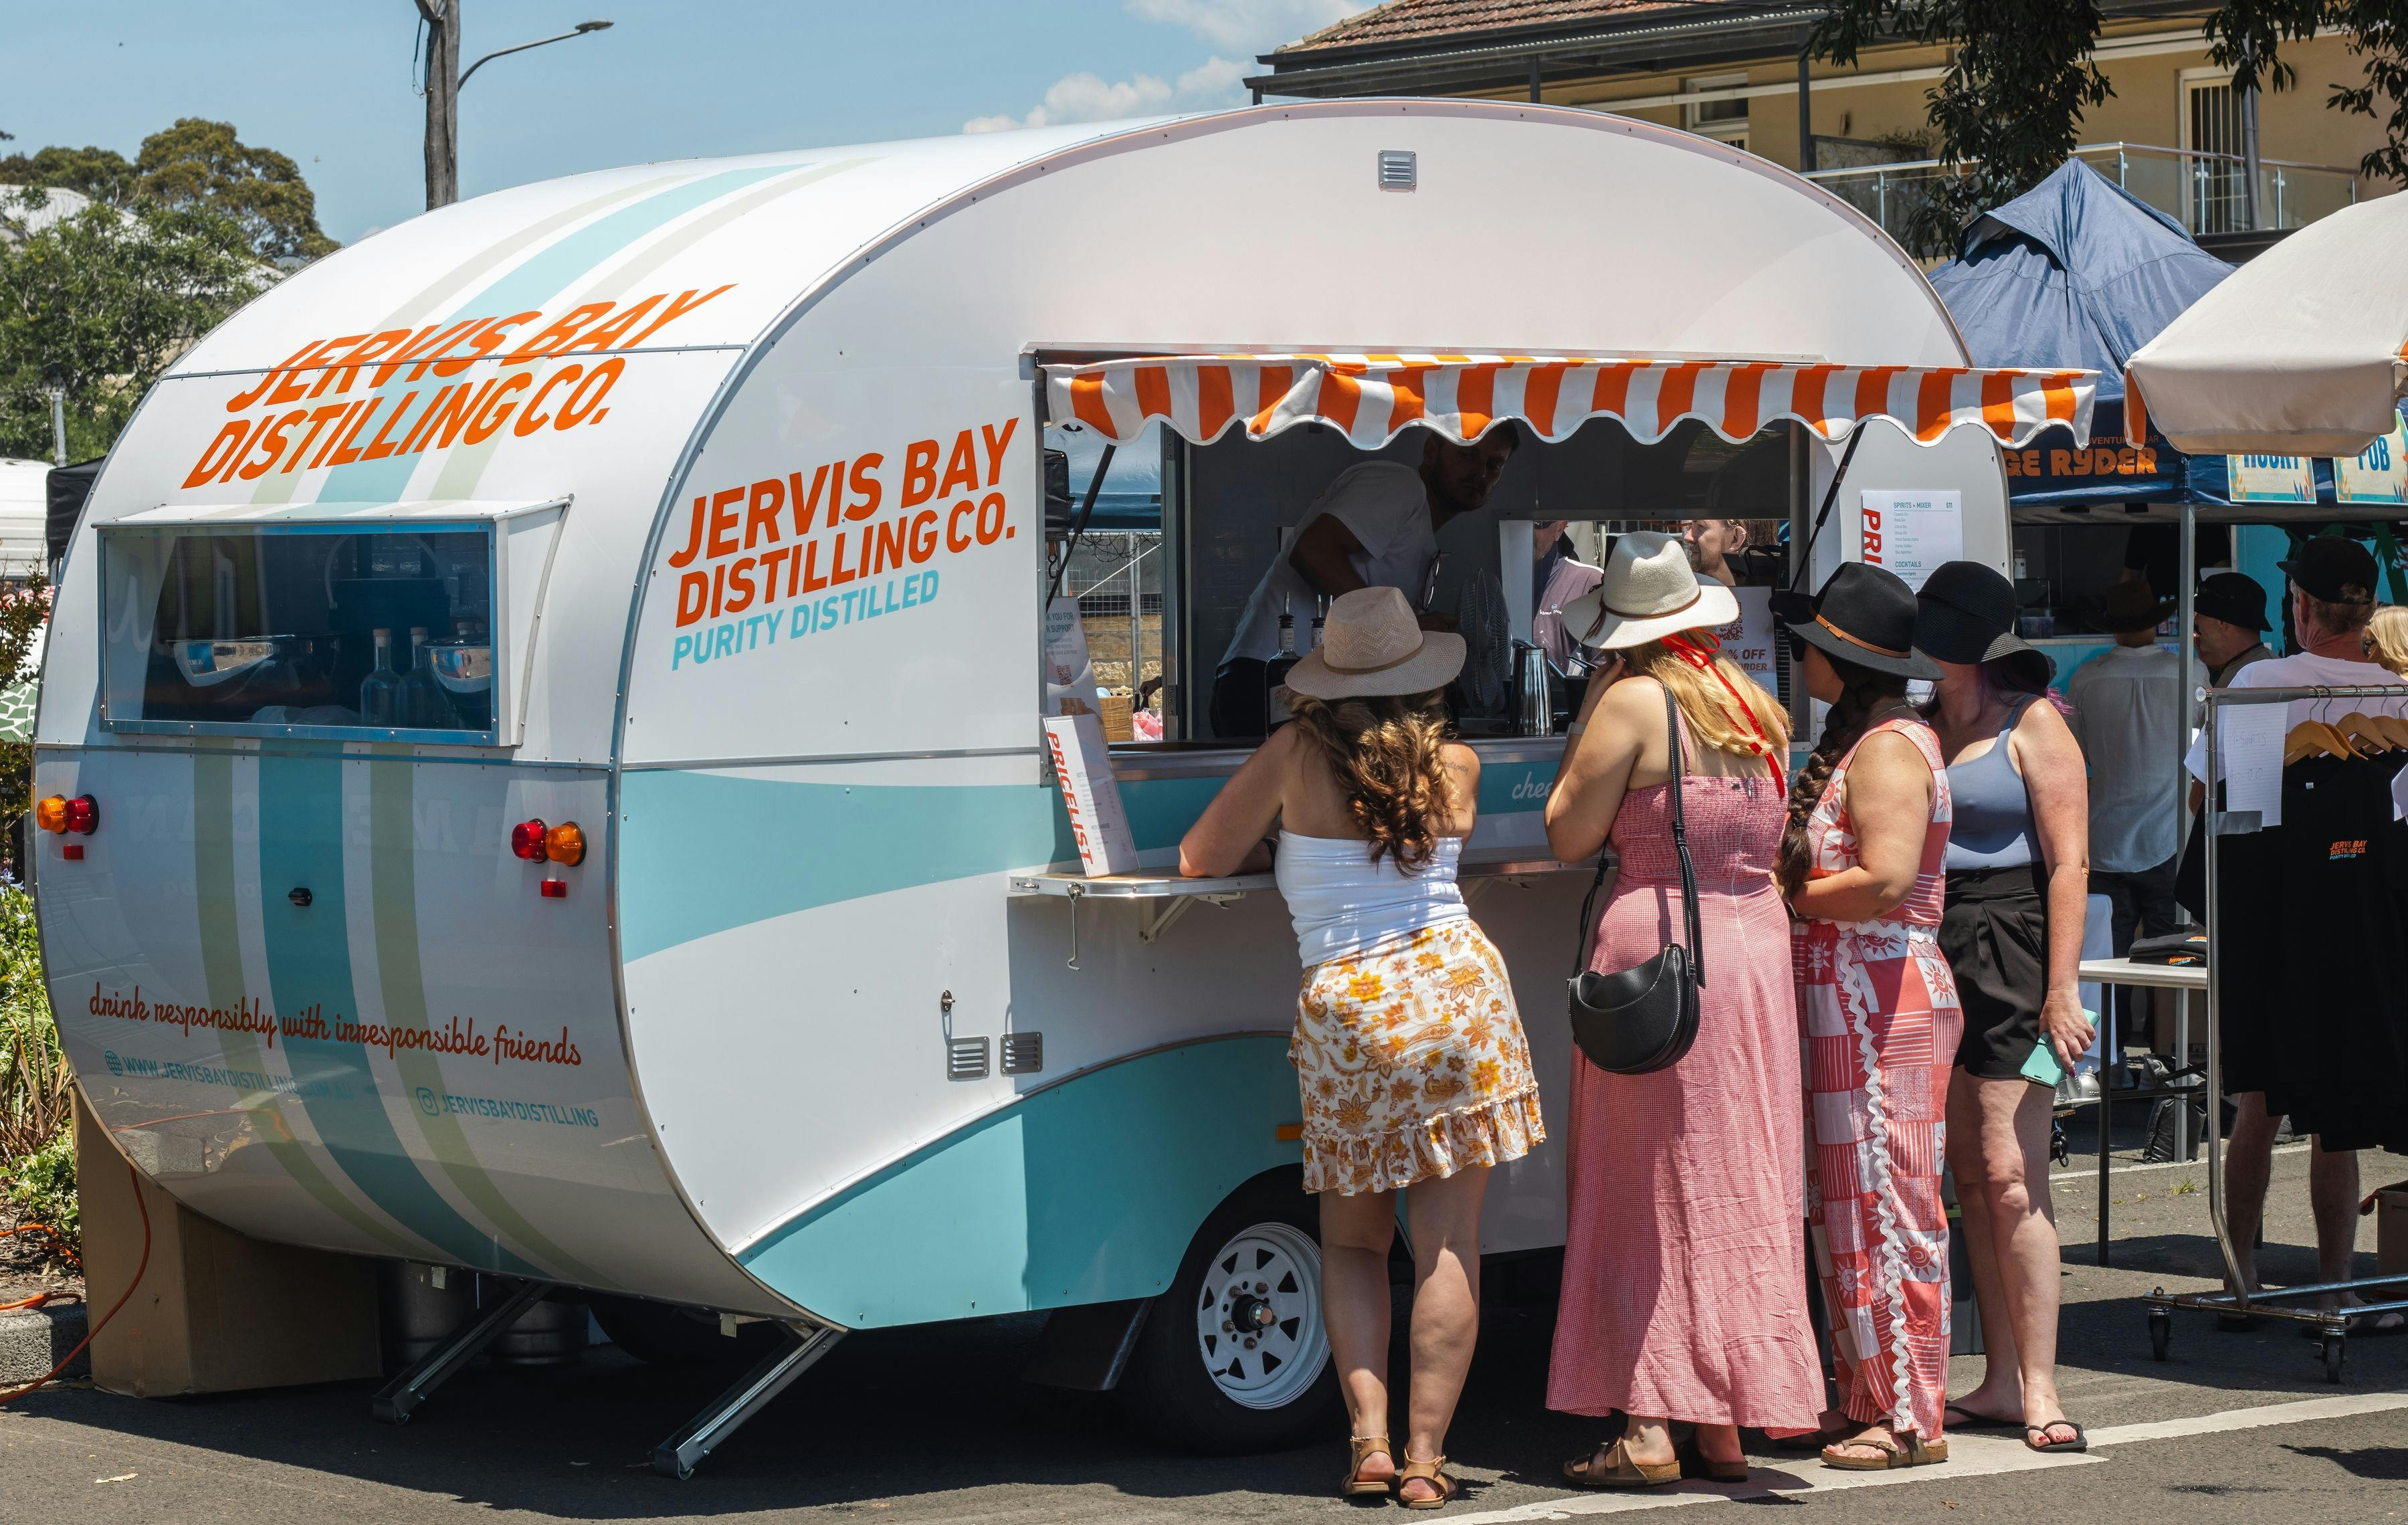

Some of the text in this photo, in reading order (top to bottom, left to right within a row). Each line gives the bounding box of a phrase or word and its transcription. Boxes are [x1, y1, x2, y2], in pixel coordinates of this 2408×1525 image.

[227, 284, 739, 413] JERVIS BAY
[180, 357, 627, 489] DISTILLING CO.
[2051, 447, 2158, 476] RYDER
[668, 417, 1019, 569] JERVIS BAY
[676, 492, 1015, 628] DISTILLING CO.
[672, 570, 940, 672] PURITY DISTILLED
[1051, 624, 1074, 633] SUPPORT
[1052, 613, 1063, 621] YOU
[1064, 612, 1074, 621] FOR
[1742, 649, 1766, 659] OFF
[90, 981, 582, 1066] drink responsibly with irresponsible friends
[442, 1094, 600, 1128] JERVISBAYDISTILLING
